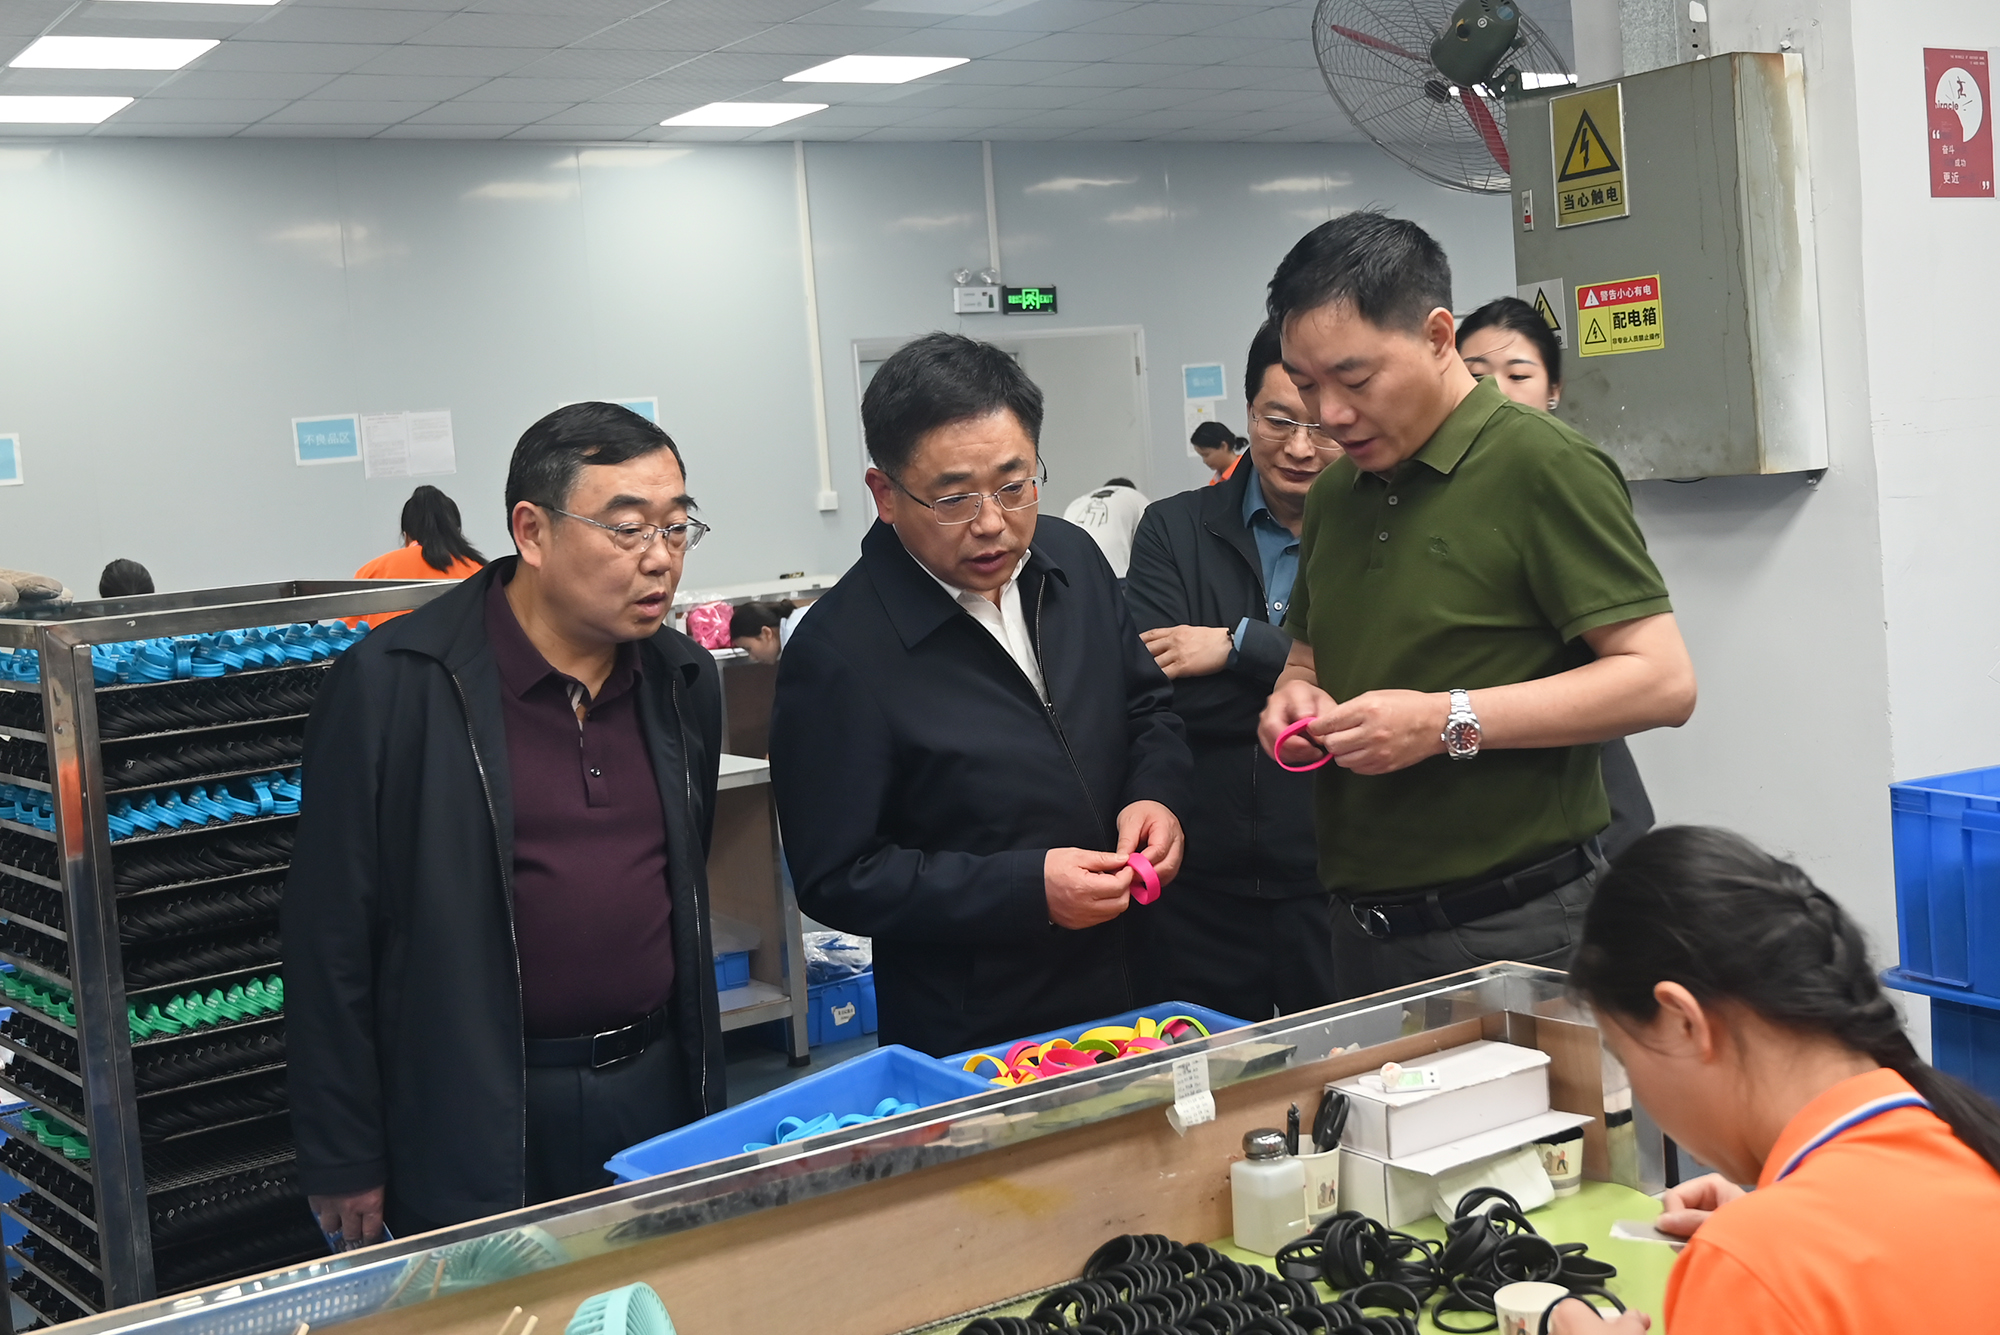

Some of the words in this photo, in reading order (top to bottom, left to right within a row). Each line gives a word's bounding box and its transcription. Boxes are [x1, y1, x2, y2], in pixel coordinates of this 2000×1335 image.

[1942, 145, 1955, 154] 奋斗
[1564, 186, 1618, 211] 当心触电
[1600, 284, 1652, 302] 警告小心有电
[1612, 306, 1657, 330] 配电箱
[304, 432, 350, 446] 不良品区
